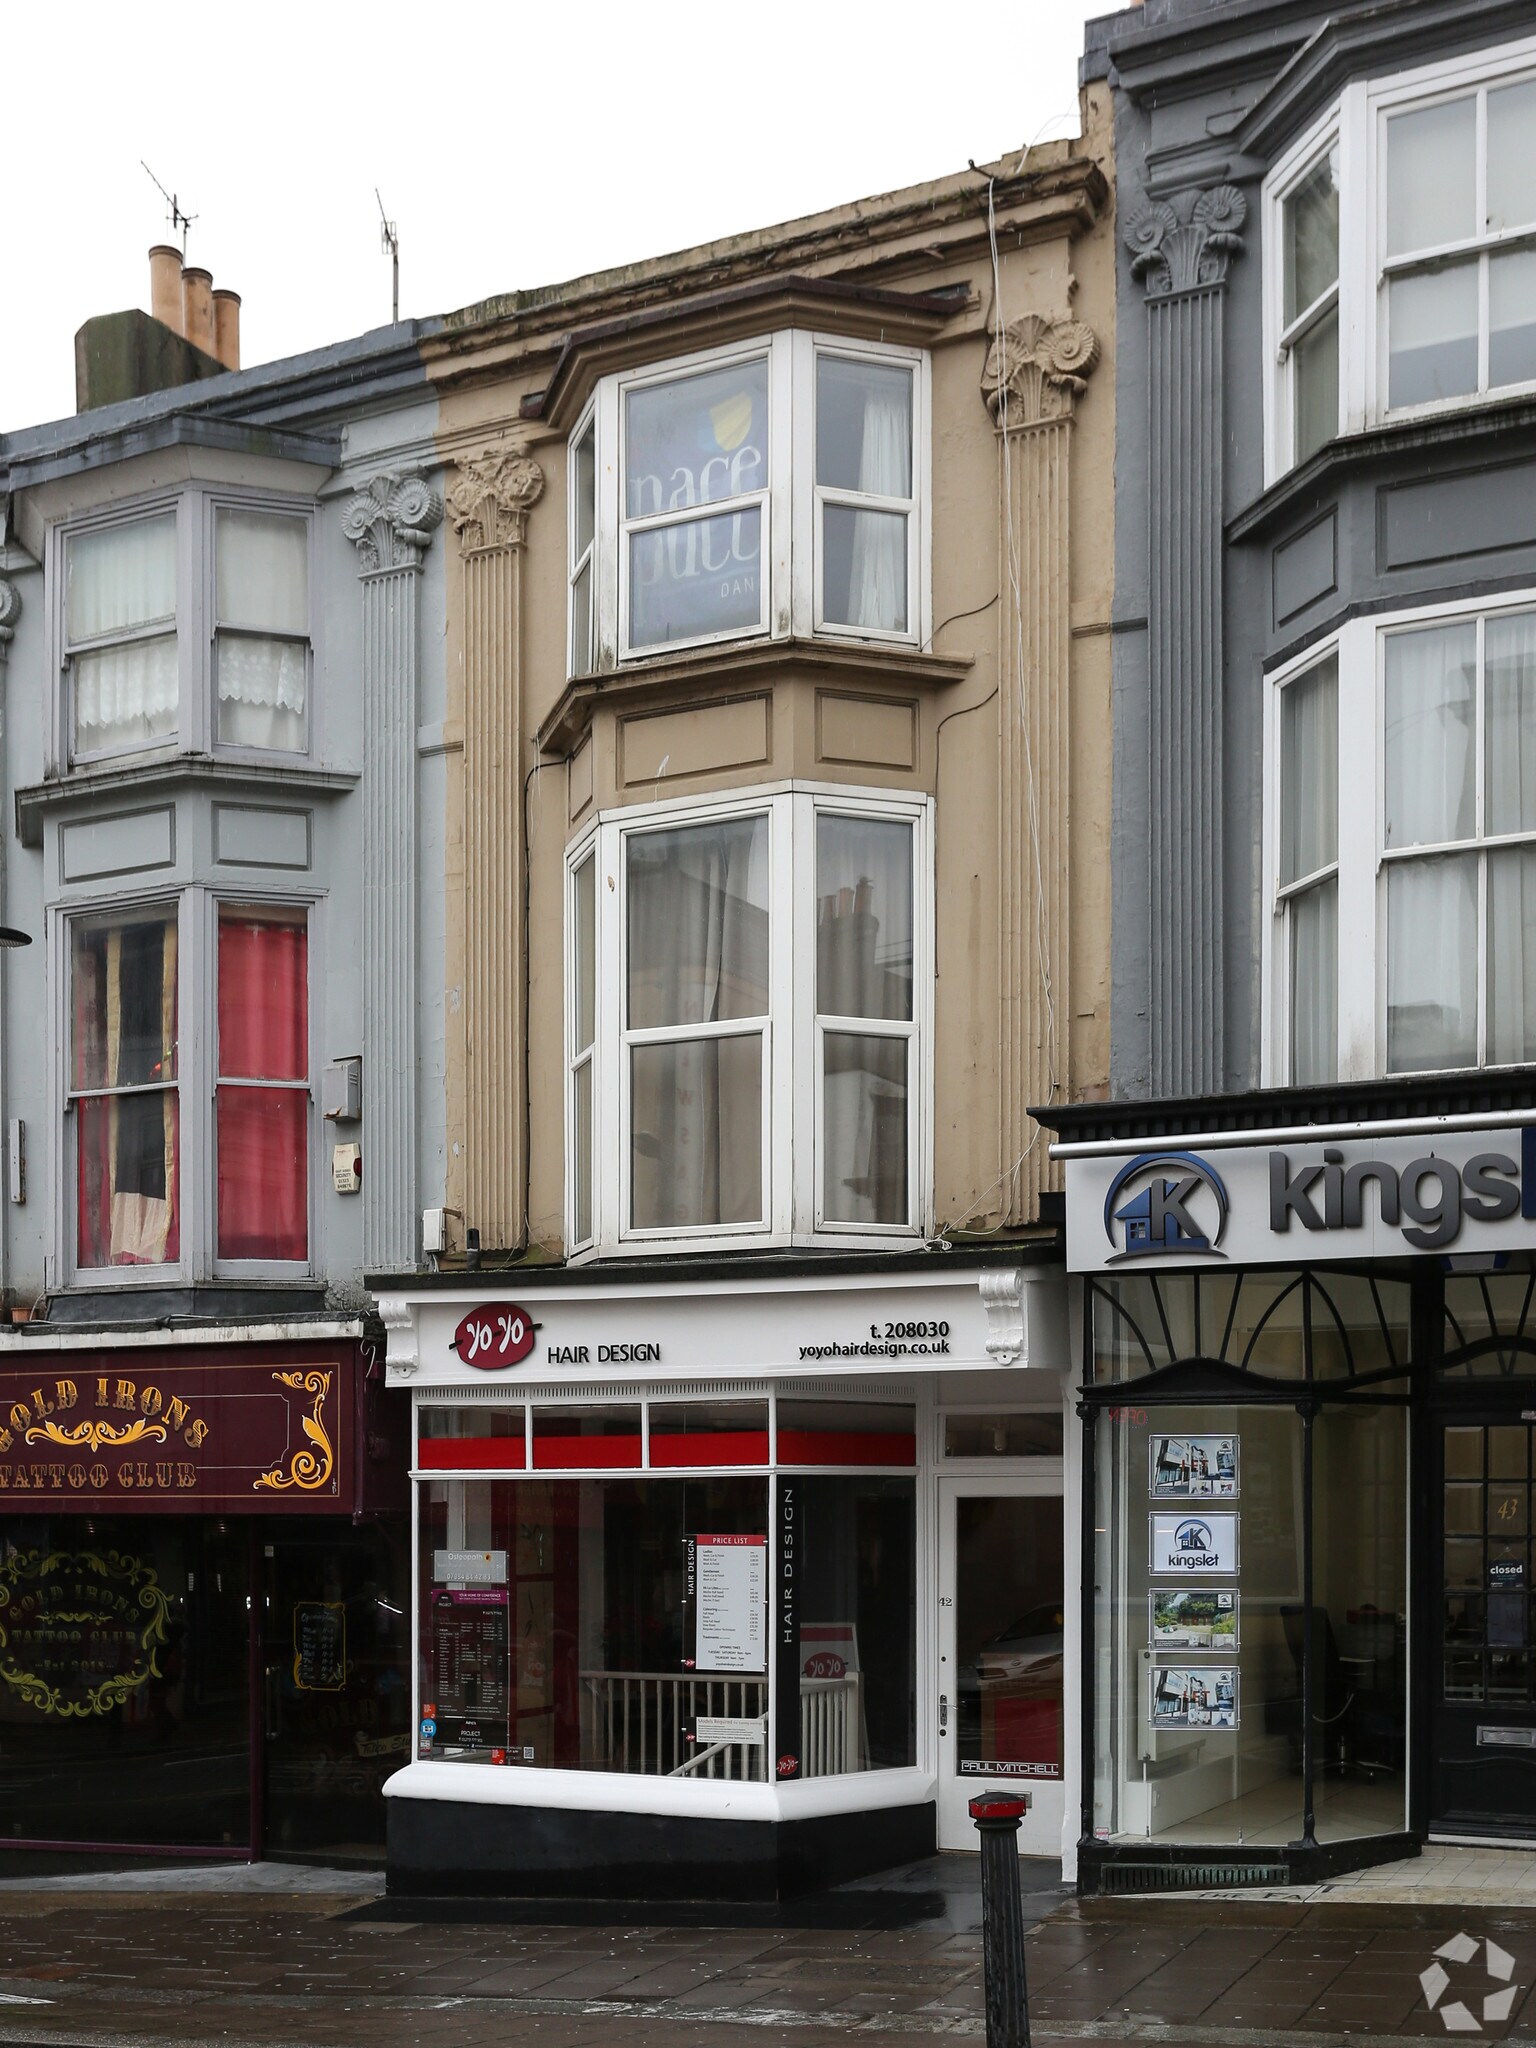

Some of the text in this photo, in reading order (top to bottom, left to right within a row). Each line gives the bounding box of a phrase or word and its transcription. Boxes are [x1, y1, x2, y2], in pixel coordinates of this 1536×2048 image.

[870, 1321, 949, 1338] t. 208030
[548, 1343, 660, 1364] HAIR DESIGN
[799, 1339, 950, 1360] yoyohairdesign.co.uk
[95, 1378, 209, 1448] IRONS
[117, 1462, 197, 1488] CLUB
[1497, 1498, 1519, 1520] 43
[448, 1552, 483, 1561] Osteopath
[784, 1489, 793, 1643] HAIR DESIGN
[1168, 1553, 1219, 1569] kingslet
[1490, 1564, 1523, 1574] closed
[9, 1584, 140, 1622] GOLD IRONS
[939, 1597, 952, 1606] 42
[12, 1630, 137, 1643] TATTOO CLUB
[961, 1762, 1059, 1774] PAUL MITCHELL
